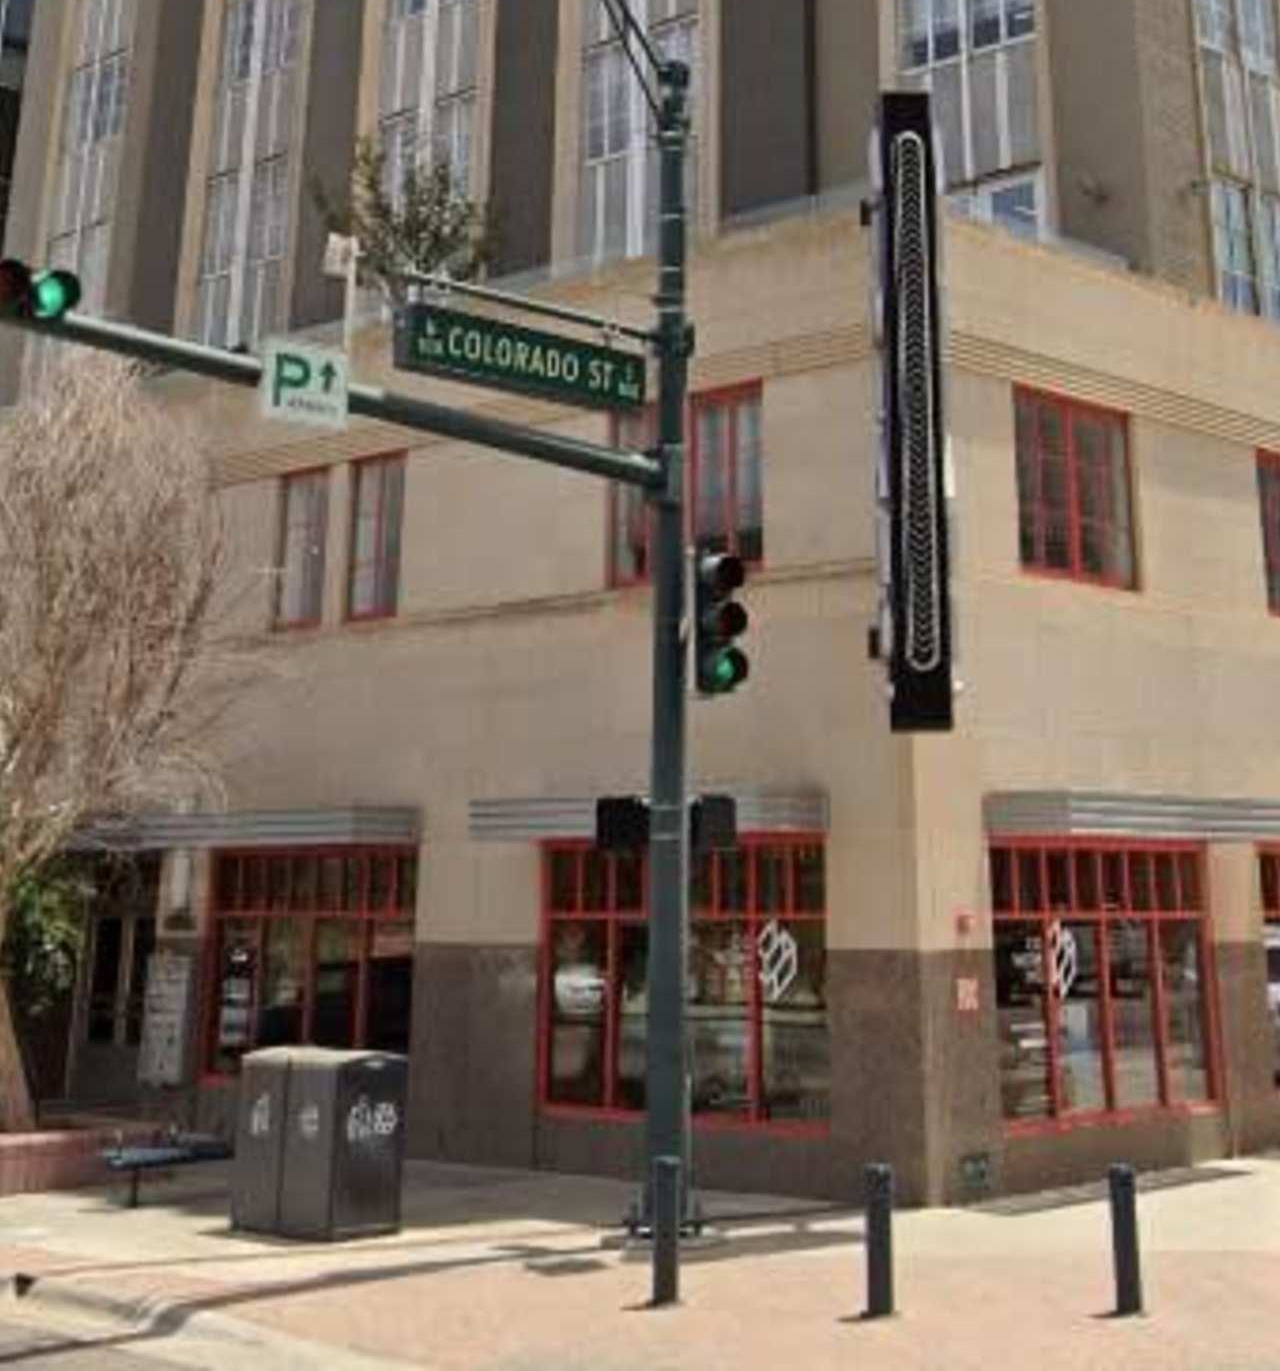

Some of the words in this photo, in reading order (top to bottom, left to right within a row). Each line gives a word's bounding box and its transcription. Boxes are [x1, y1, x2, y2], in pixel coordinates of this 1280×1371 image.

[273, 353, 311, 407] P
[448, 326, 579, 381] COLORADO
[588, 360, 613, 391] ST
